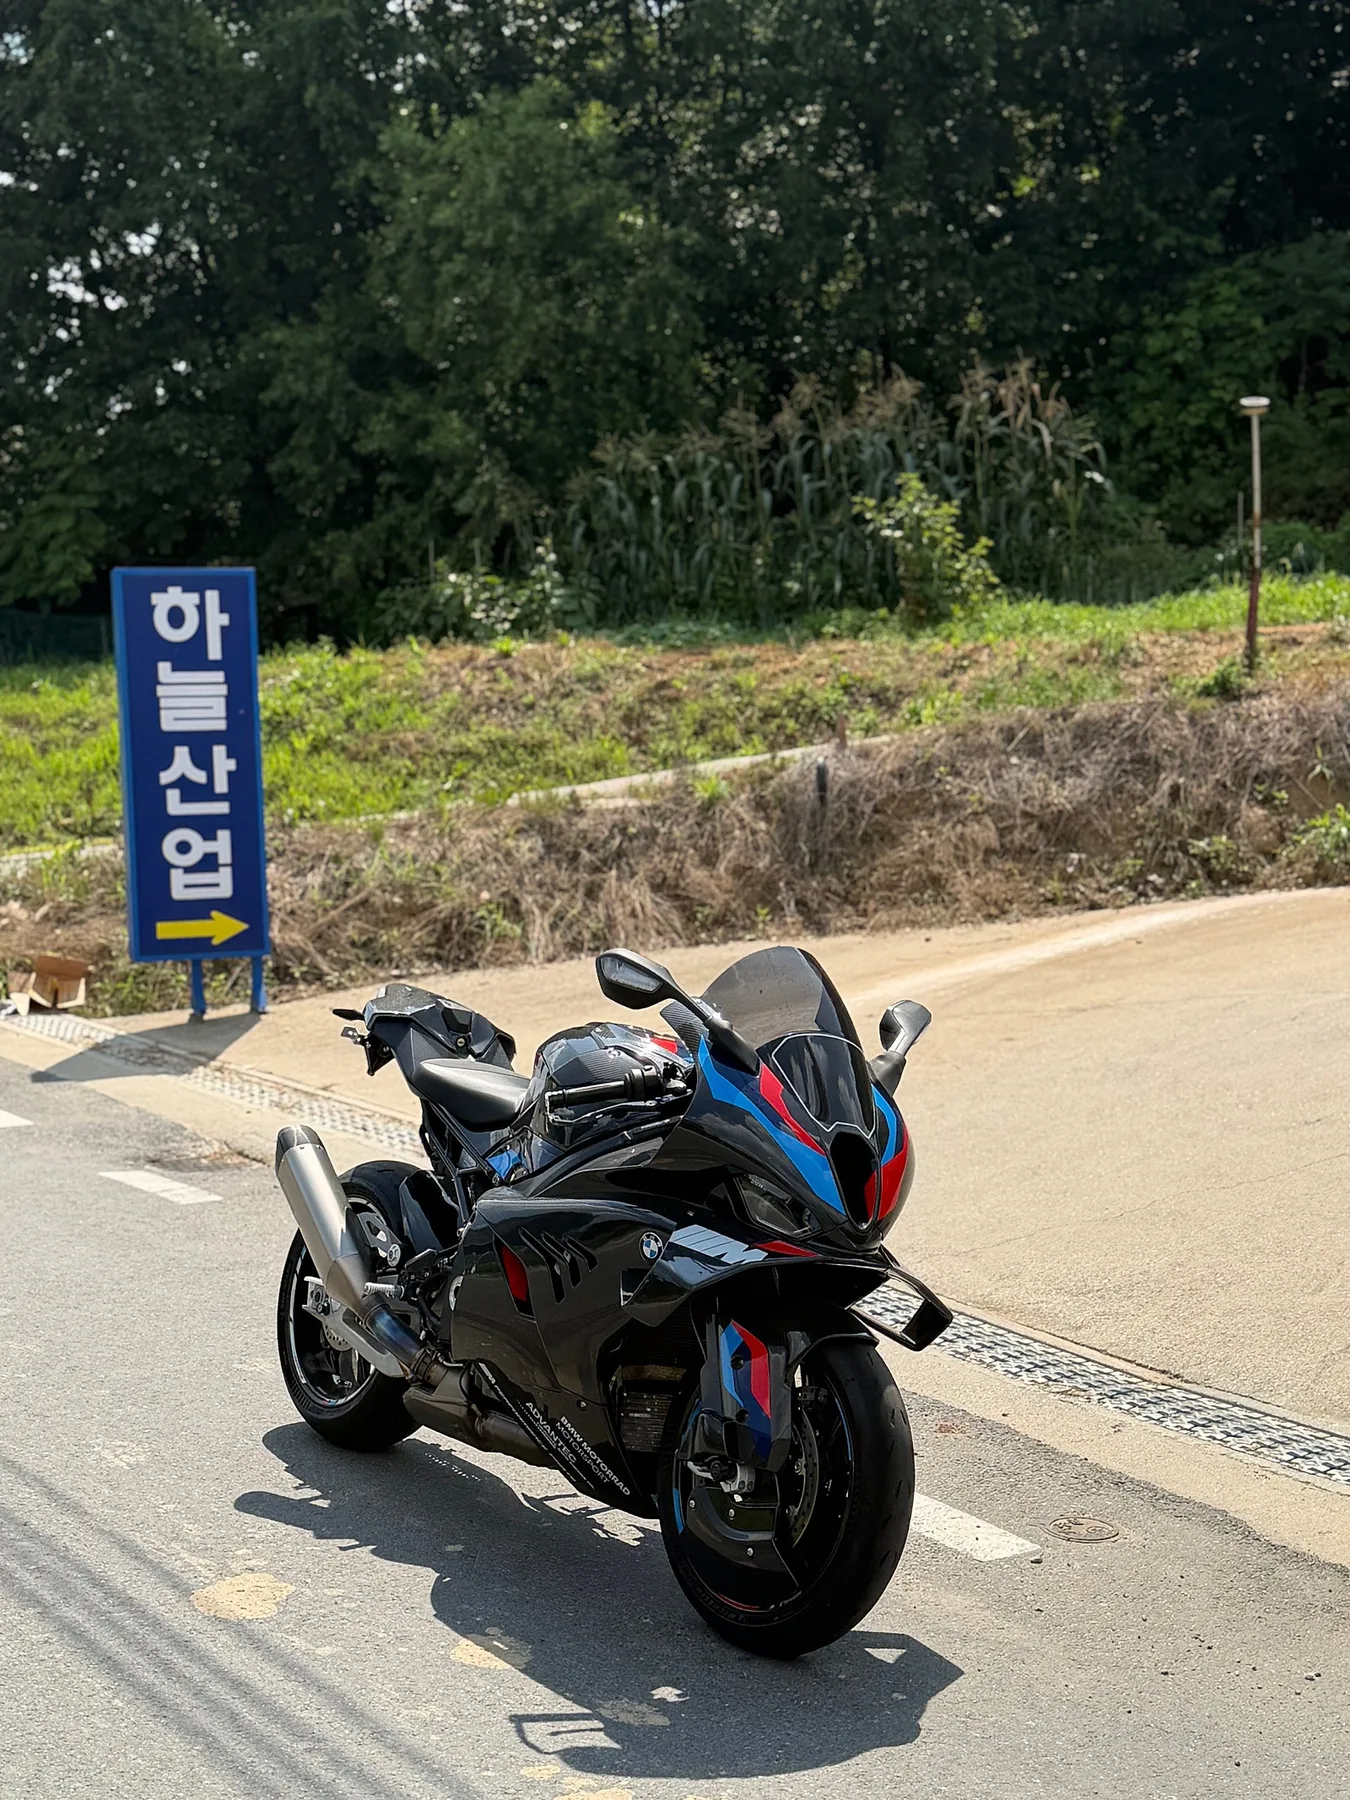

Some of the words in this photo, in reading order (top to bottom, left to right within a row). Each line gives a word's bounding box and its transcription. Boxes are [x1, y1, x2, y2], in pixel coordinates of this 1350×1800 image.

[150, 586, 237, 901] 하늘산업
[525, 1402, 577, 1463] ADVANTEC
[555, 1422, 610, 1483] MOTORSPORT
[560, 1416, 583, 1442] BMW
[581, 1441, 631, 1496] MOTORRAD
